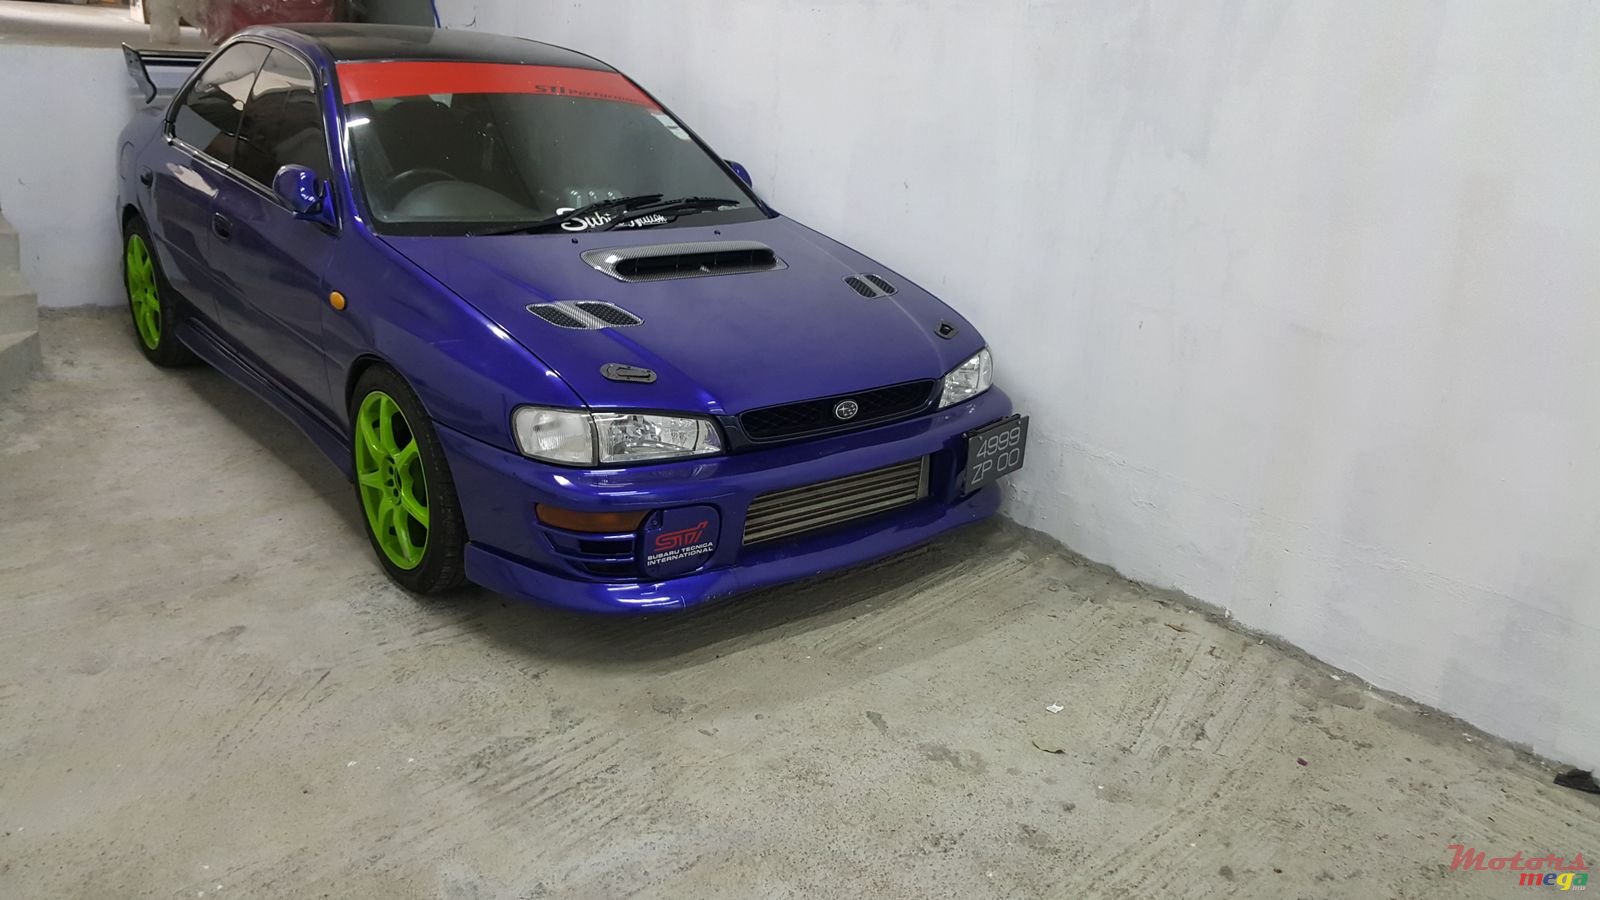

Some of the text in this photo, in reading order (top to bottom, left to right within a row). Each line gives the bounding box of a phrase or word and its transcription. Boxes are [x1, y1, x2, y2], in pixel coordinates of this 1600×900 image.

[976, 426, 1020, 458] 4999
[971, 459, 992, 484] ZP
[647, 541, 714, 561] SUBARU TECNICA
[647, 546, 714, 566] INTERNATIONAL
